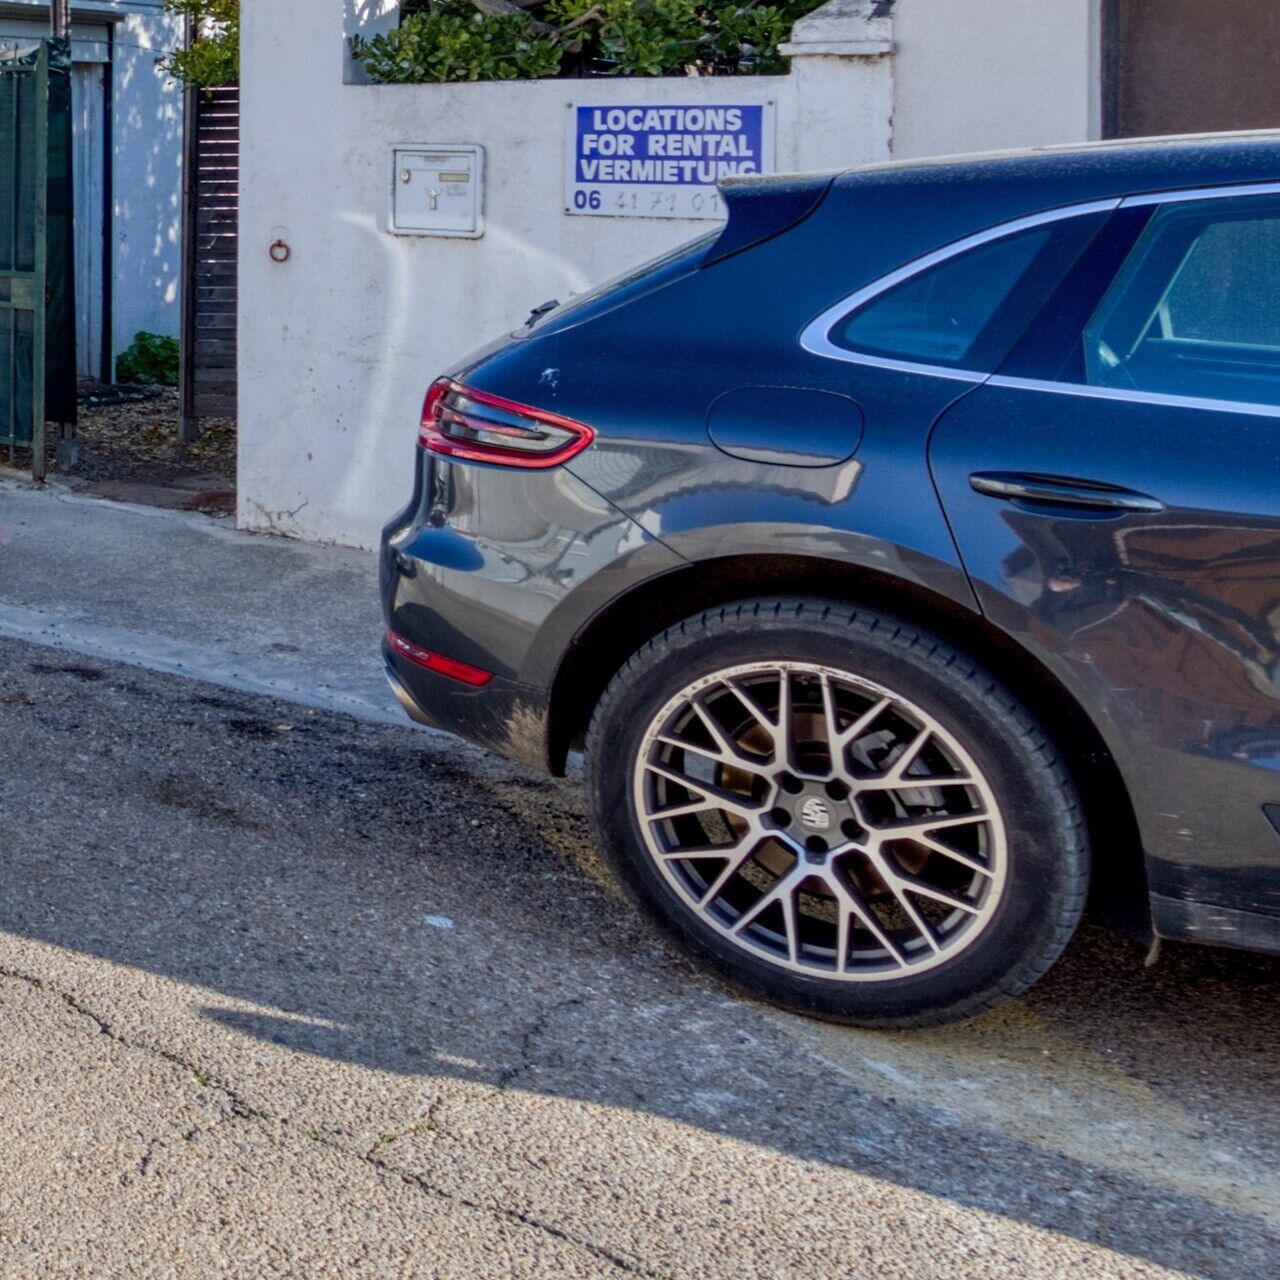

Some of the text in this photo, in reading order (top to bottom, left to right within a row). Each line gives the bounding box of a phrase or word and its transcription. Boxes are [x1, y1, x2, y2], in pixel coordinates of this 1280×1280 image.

[593, 108, 743, 131] LOCATIONS
[582, 134, 754, 157] FOR RENTAL
[573, 189, 602, 210] 06
